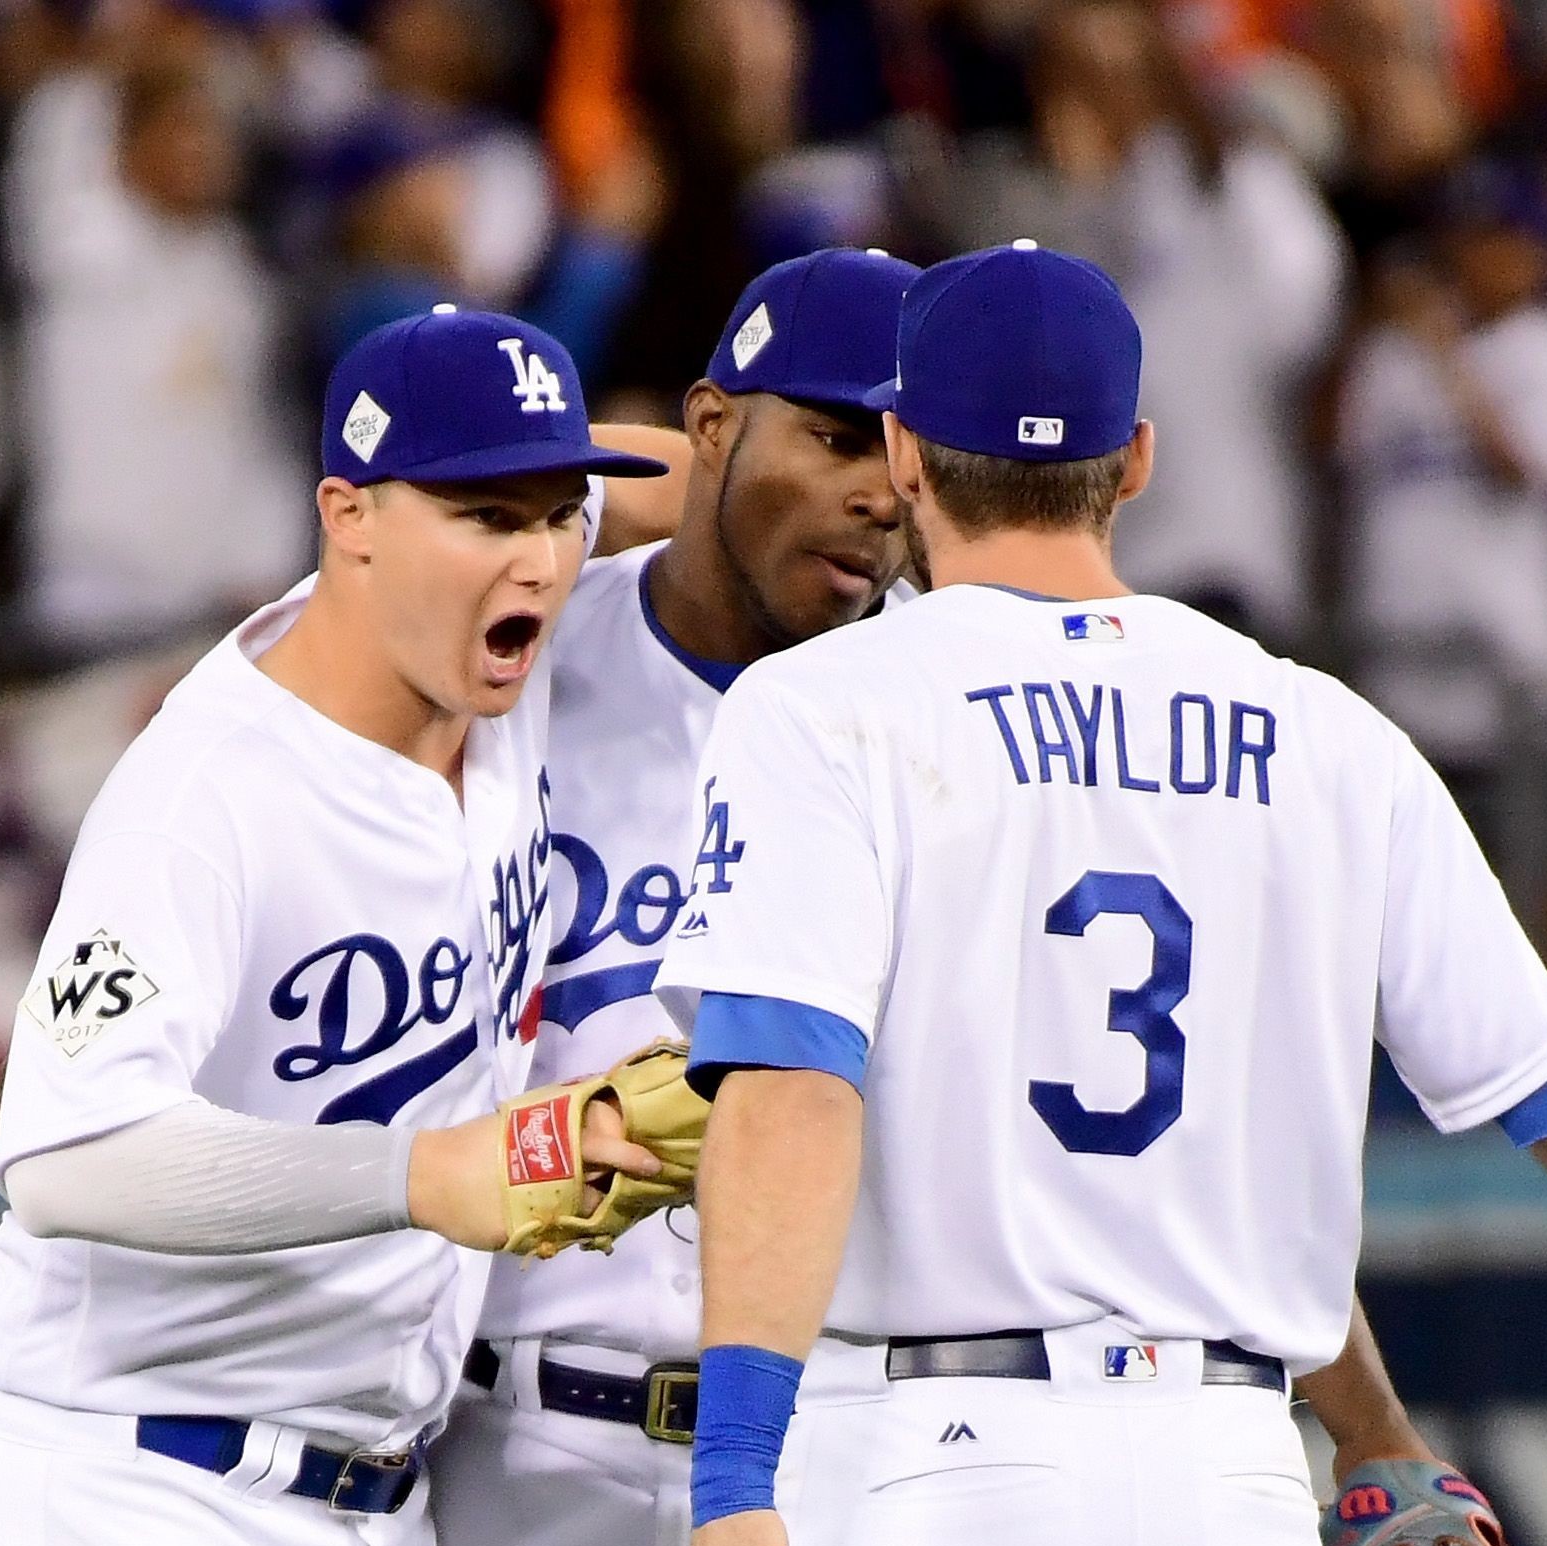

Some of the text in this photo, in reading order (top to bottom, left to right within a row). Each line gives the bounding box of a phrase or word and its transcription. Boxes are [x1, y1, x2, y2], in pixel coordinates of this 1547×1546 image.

[497, 338, 566, 412] LA
[965, 680, 1276, 806] TAYLOR
[48, 969, 137, 1023] WS
[55, 1023, 104, 1042] 2017
[1028, 869, 1193, 1156] 3
